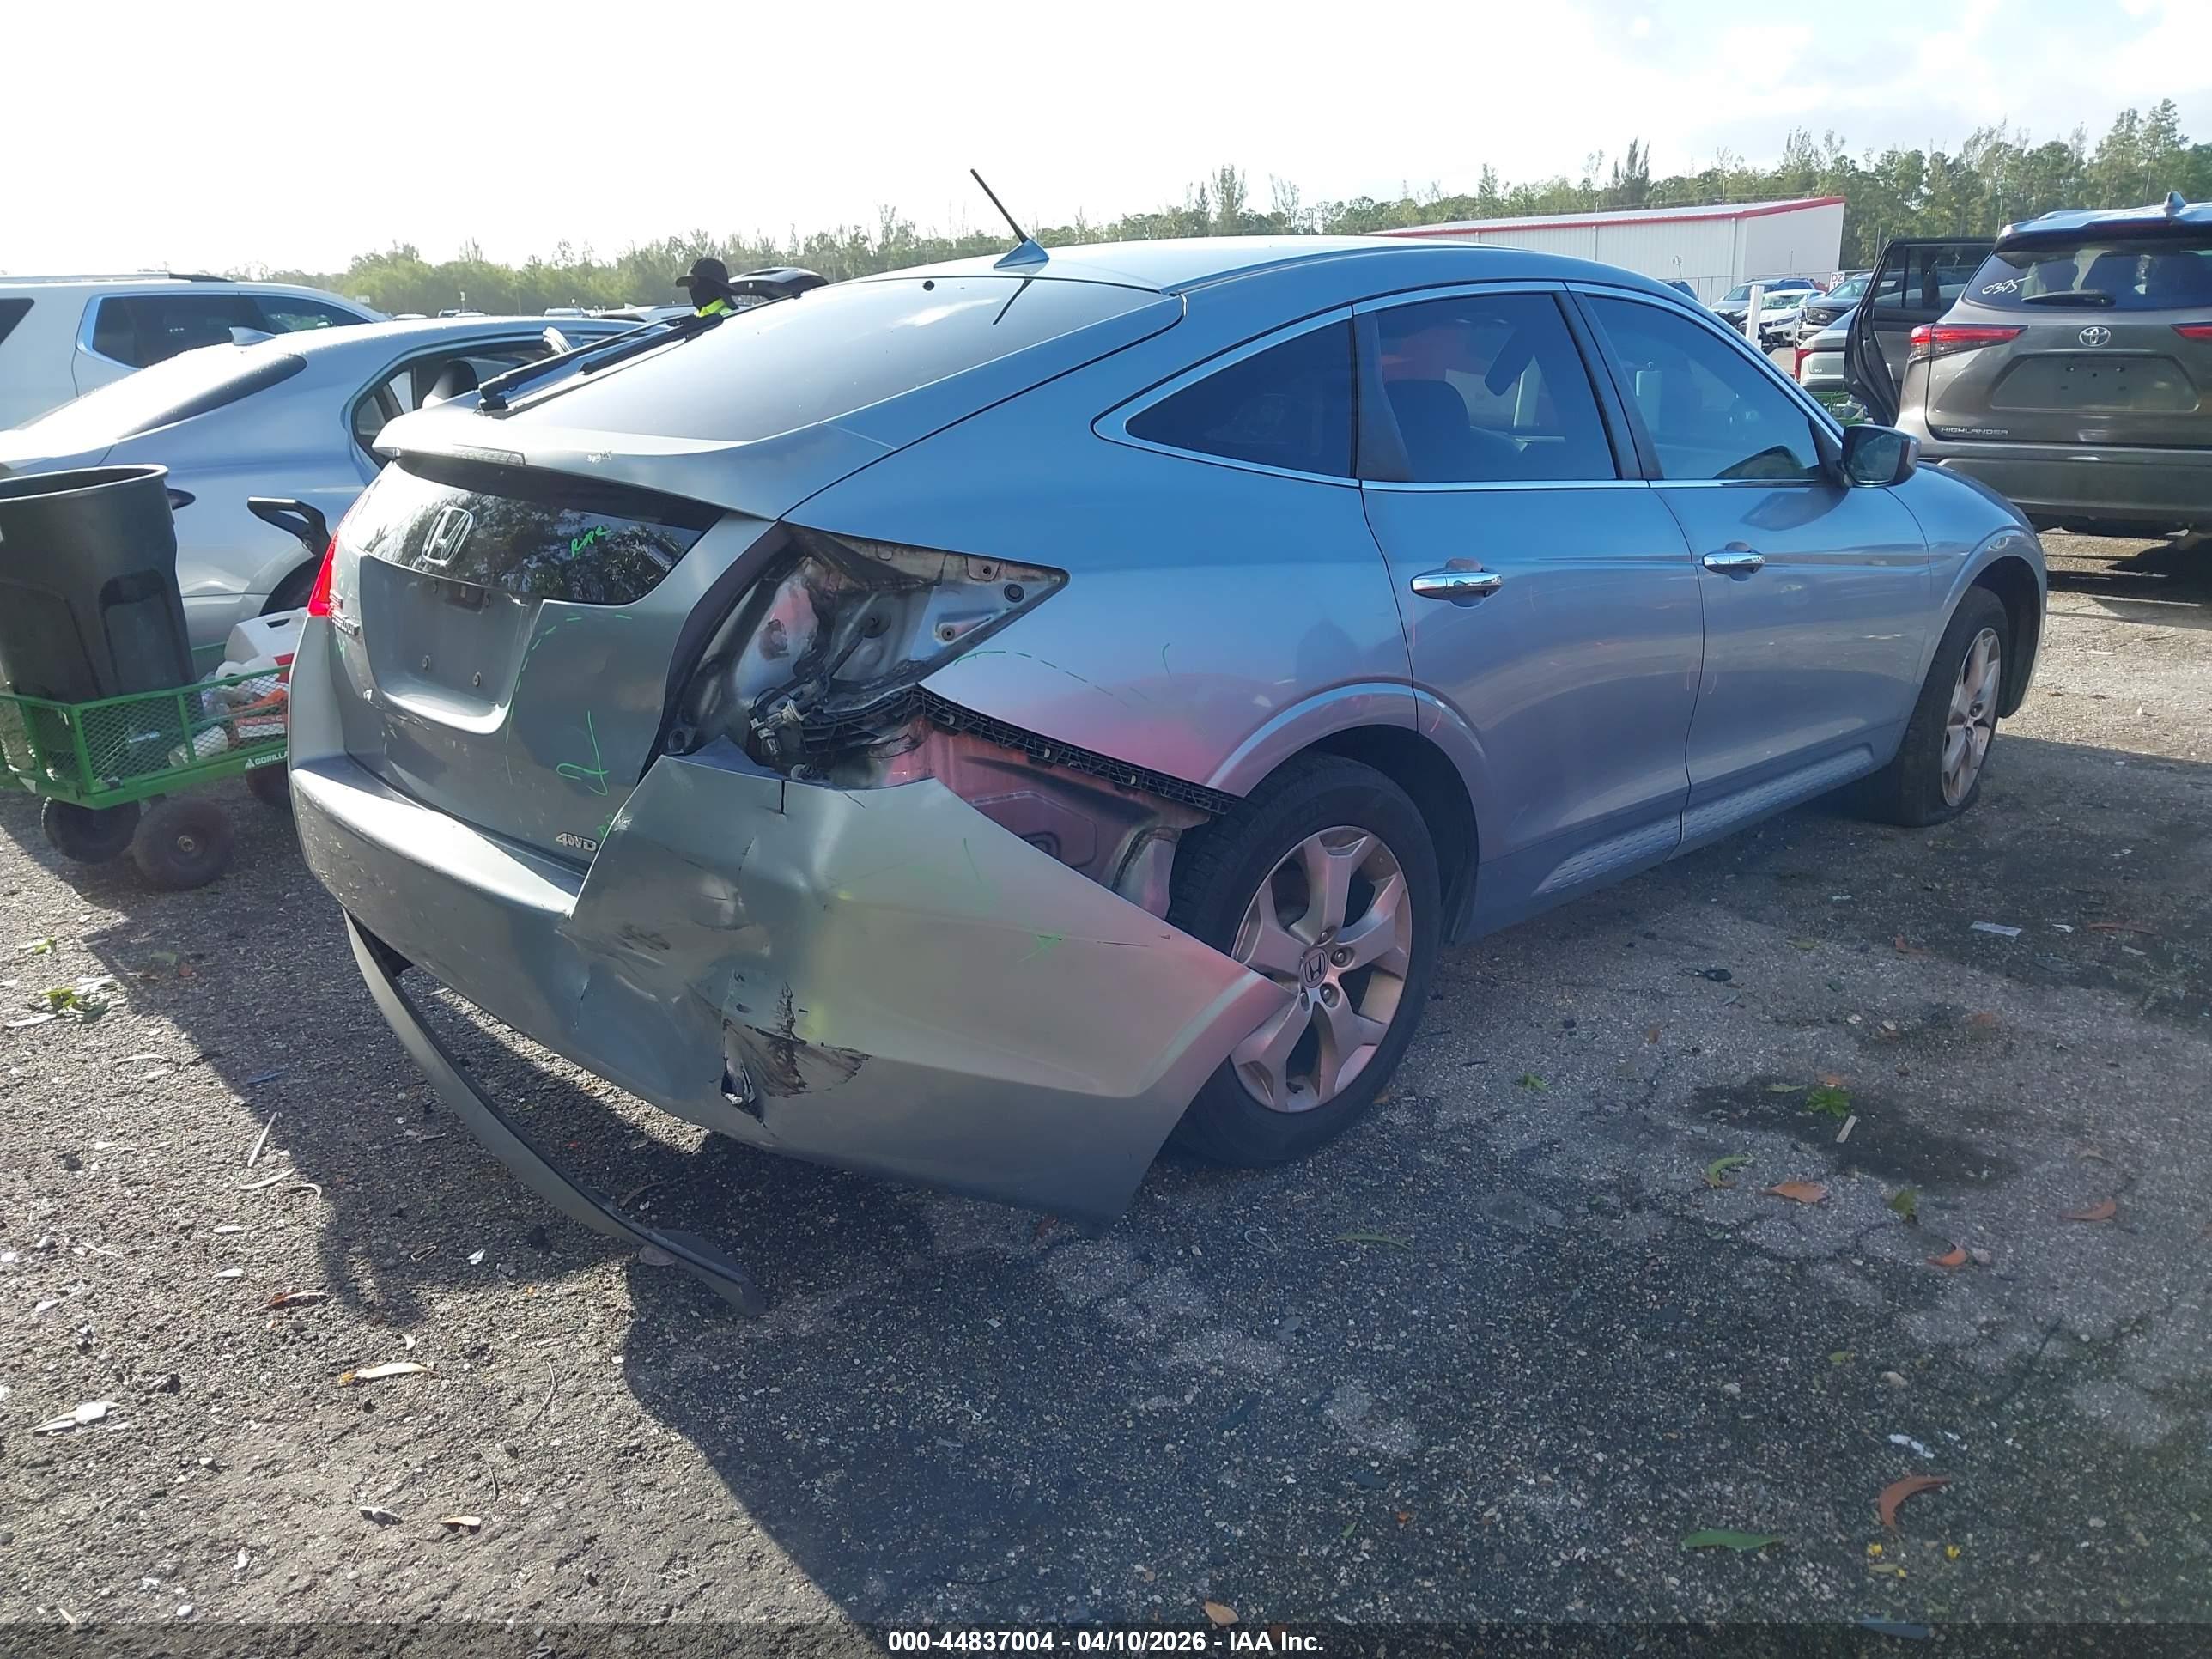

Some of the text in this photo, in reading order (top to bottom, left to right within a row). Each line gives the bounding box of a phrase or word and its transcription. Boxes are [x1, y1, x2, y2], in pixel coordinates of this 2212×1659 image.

[1940, 427, 2008, 435] HIGHLANDER
[254, 750, 289, 766] GORILLA
[555, 832, 597, 852] 4WD
